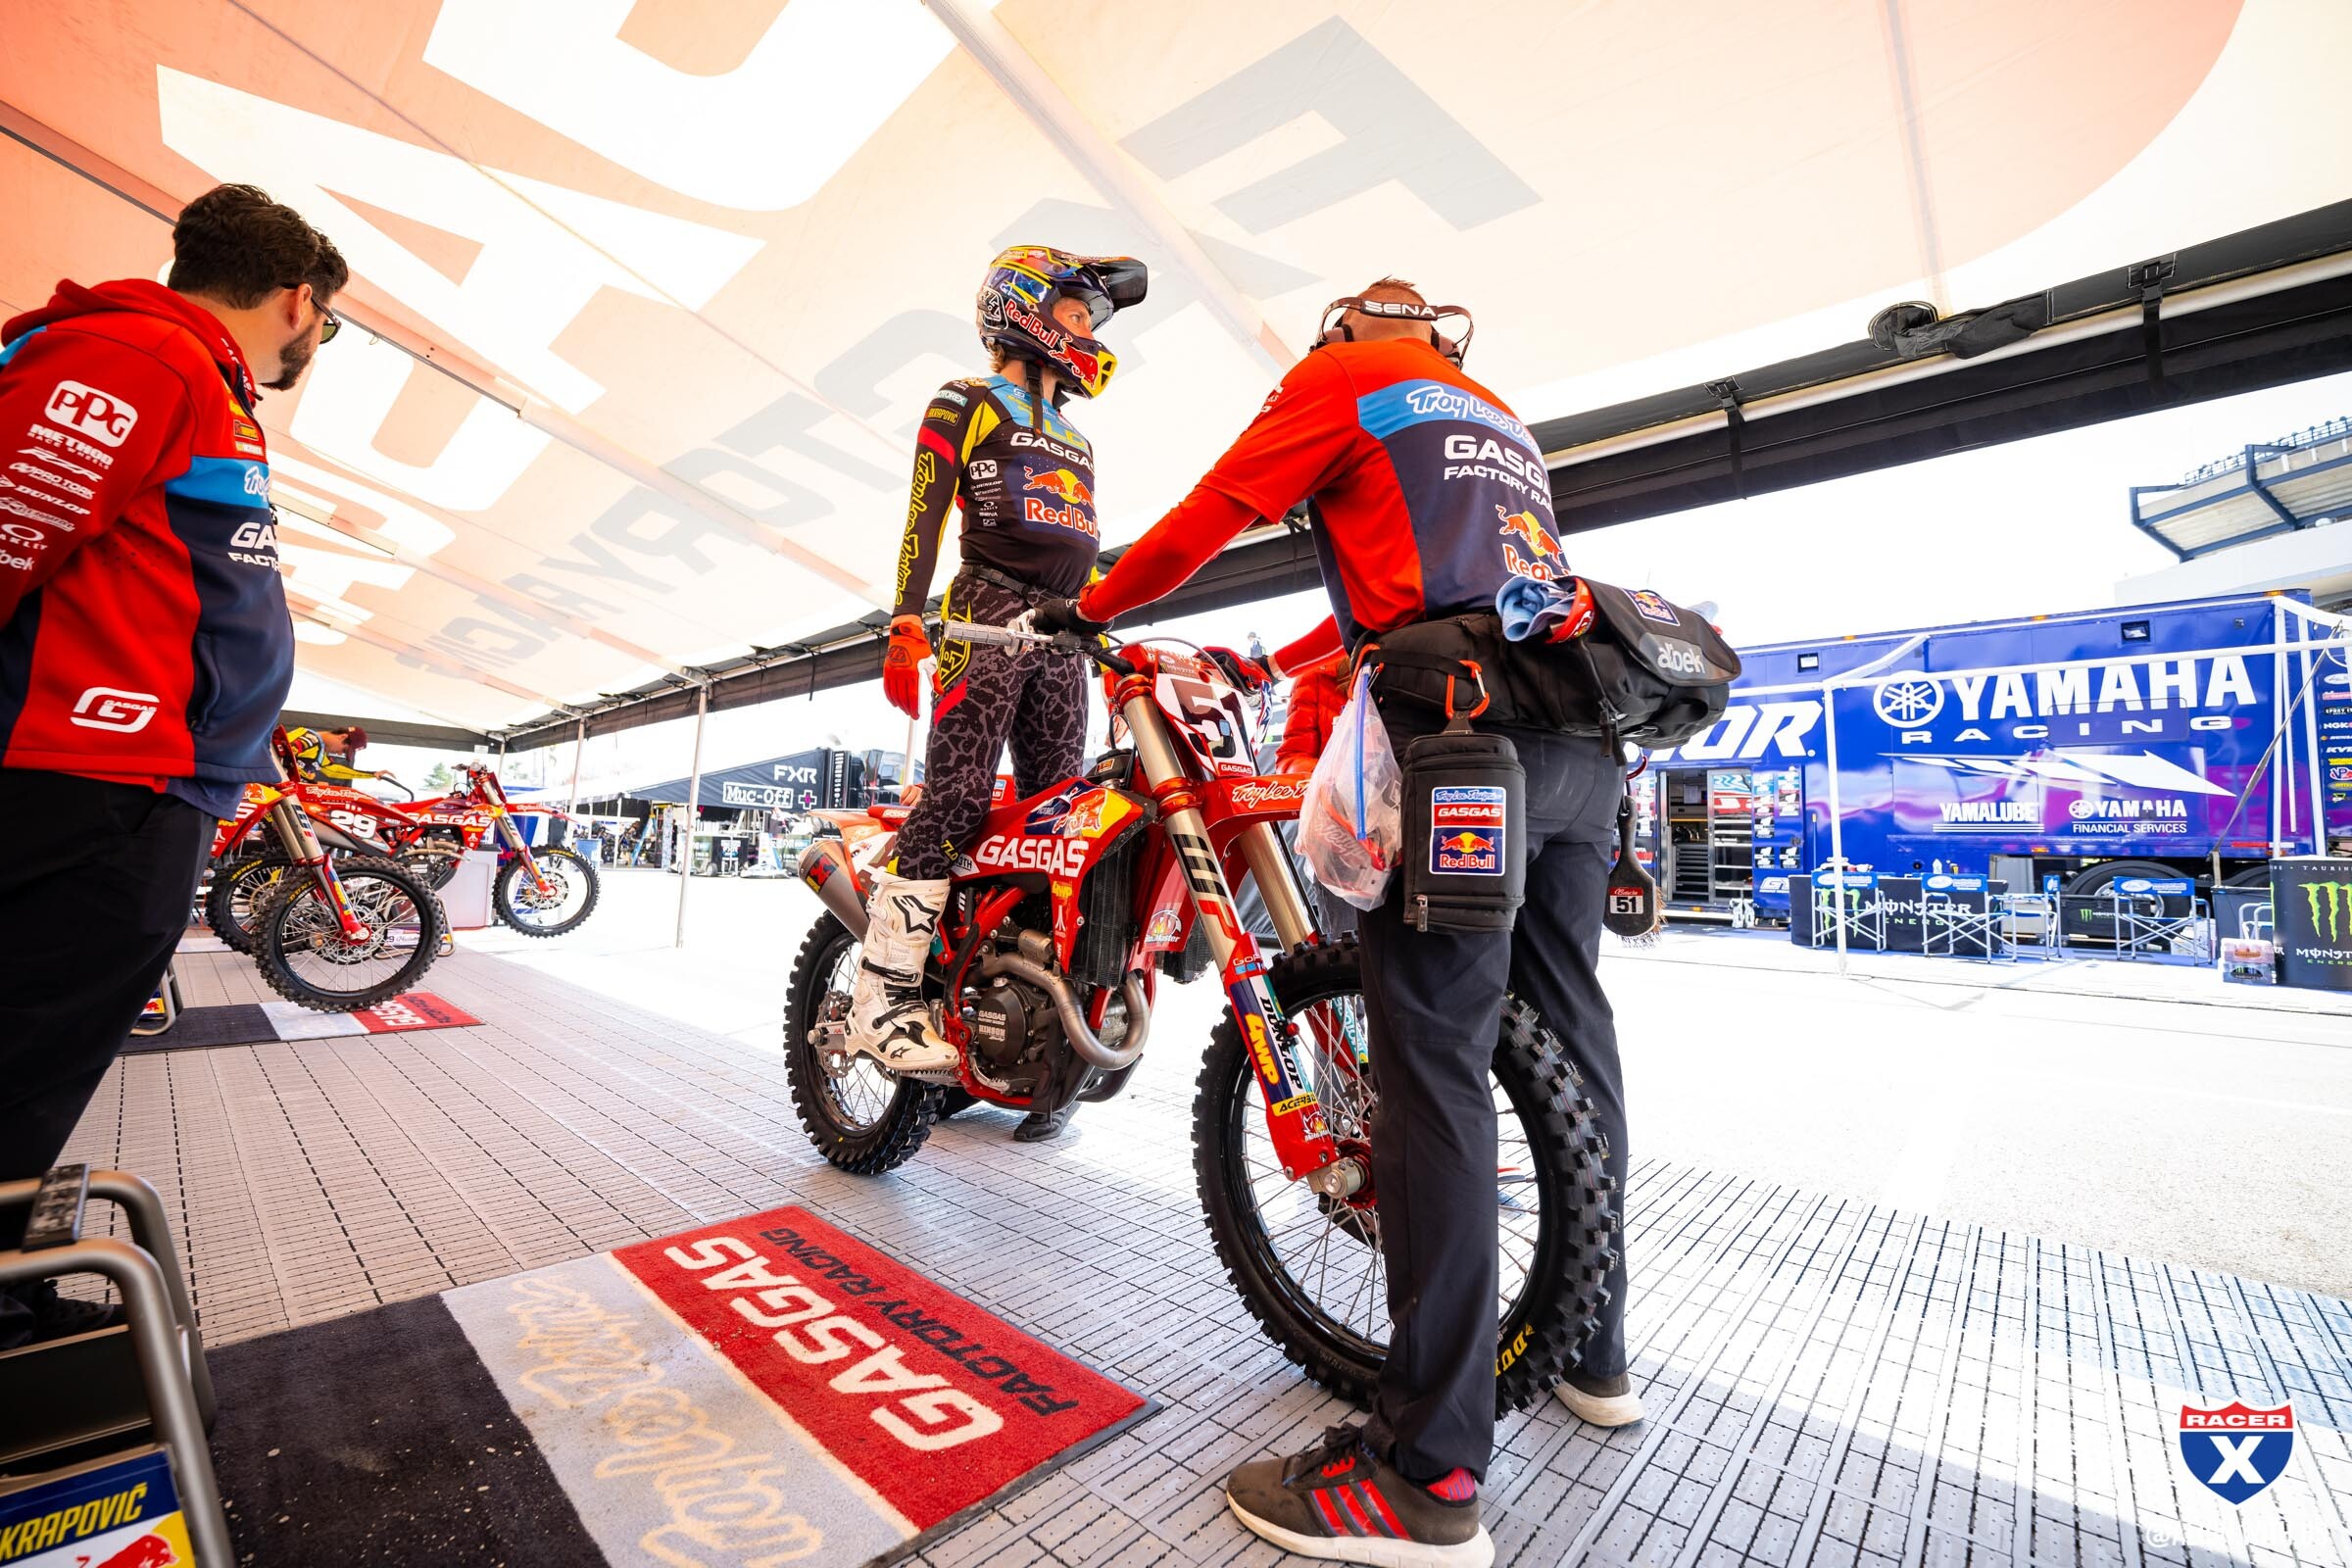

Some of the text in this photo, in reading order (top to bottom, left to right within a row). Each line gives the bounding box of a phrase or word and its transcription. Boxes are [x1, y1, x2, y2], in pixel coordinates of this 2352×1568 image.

[1364, 300, 1437, 317] SENA
[1005, 299, 1060, 348] Red Bull
[51, 389, 130, 438] PPG
[1406, 386, 1469, 418] Troy
[27, 432, 110, 470] RACE WHEELS
[29, 424, 114, 466] METHOD
[17, 447, 103, 482] RZR
[970, 462, 996, 477] PPG
[31, 467, 96, 498] PRO TORK
[1444, 465, 1530, 494] FACTORY
[14, 485, 92, 515] DUNLOP
[1024, 497, 1071, 531] Red
[1951, 655, 2257, 721] YAMAHA
[103, 699, 157, 712] GASGAS
[1170, 679, 1252, 763] 51
[1901, 715, 2233, 745] RACING
[774, 764, 817, 784] FXR
[1221, 763, 1252, 775] GASGAS
[726, 786, 791, 806] Muc-Off
[1232, 782, 1266, 808] Troy
[1261, 781, 1294, 800] Lee
[406, 812, 492, 826] GASGAS
[1438, 808, 1502, 817] GASGAS
[1939, 802, 2039, 822] YAMALUBE
[2096, 799, 2187, 819] YAMAHA
[330, 809, 377, 838] 29
[2073, 823, 2187, 834] FINANCIAL SERVICES
[941, 840, 958, 861] TLD
[976, 834, 1090, 878] GASGAS
[1440, 854, 1495, 869] Red Bull
[233, 859, 264, 879] DUNLOP
[1616, 897, 1637, 913] 51
[1864, 900, 1973, 915] MONSTER
[978, 1010, 1006, 1021] GASGAS
[759, 1228, 1080, 1417] FACTORY RACING
[663, 1236, 1004, 1451] GASGAS
